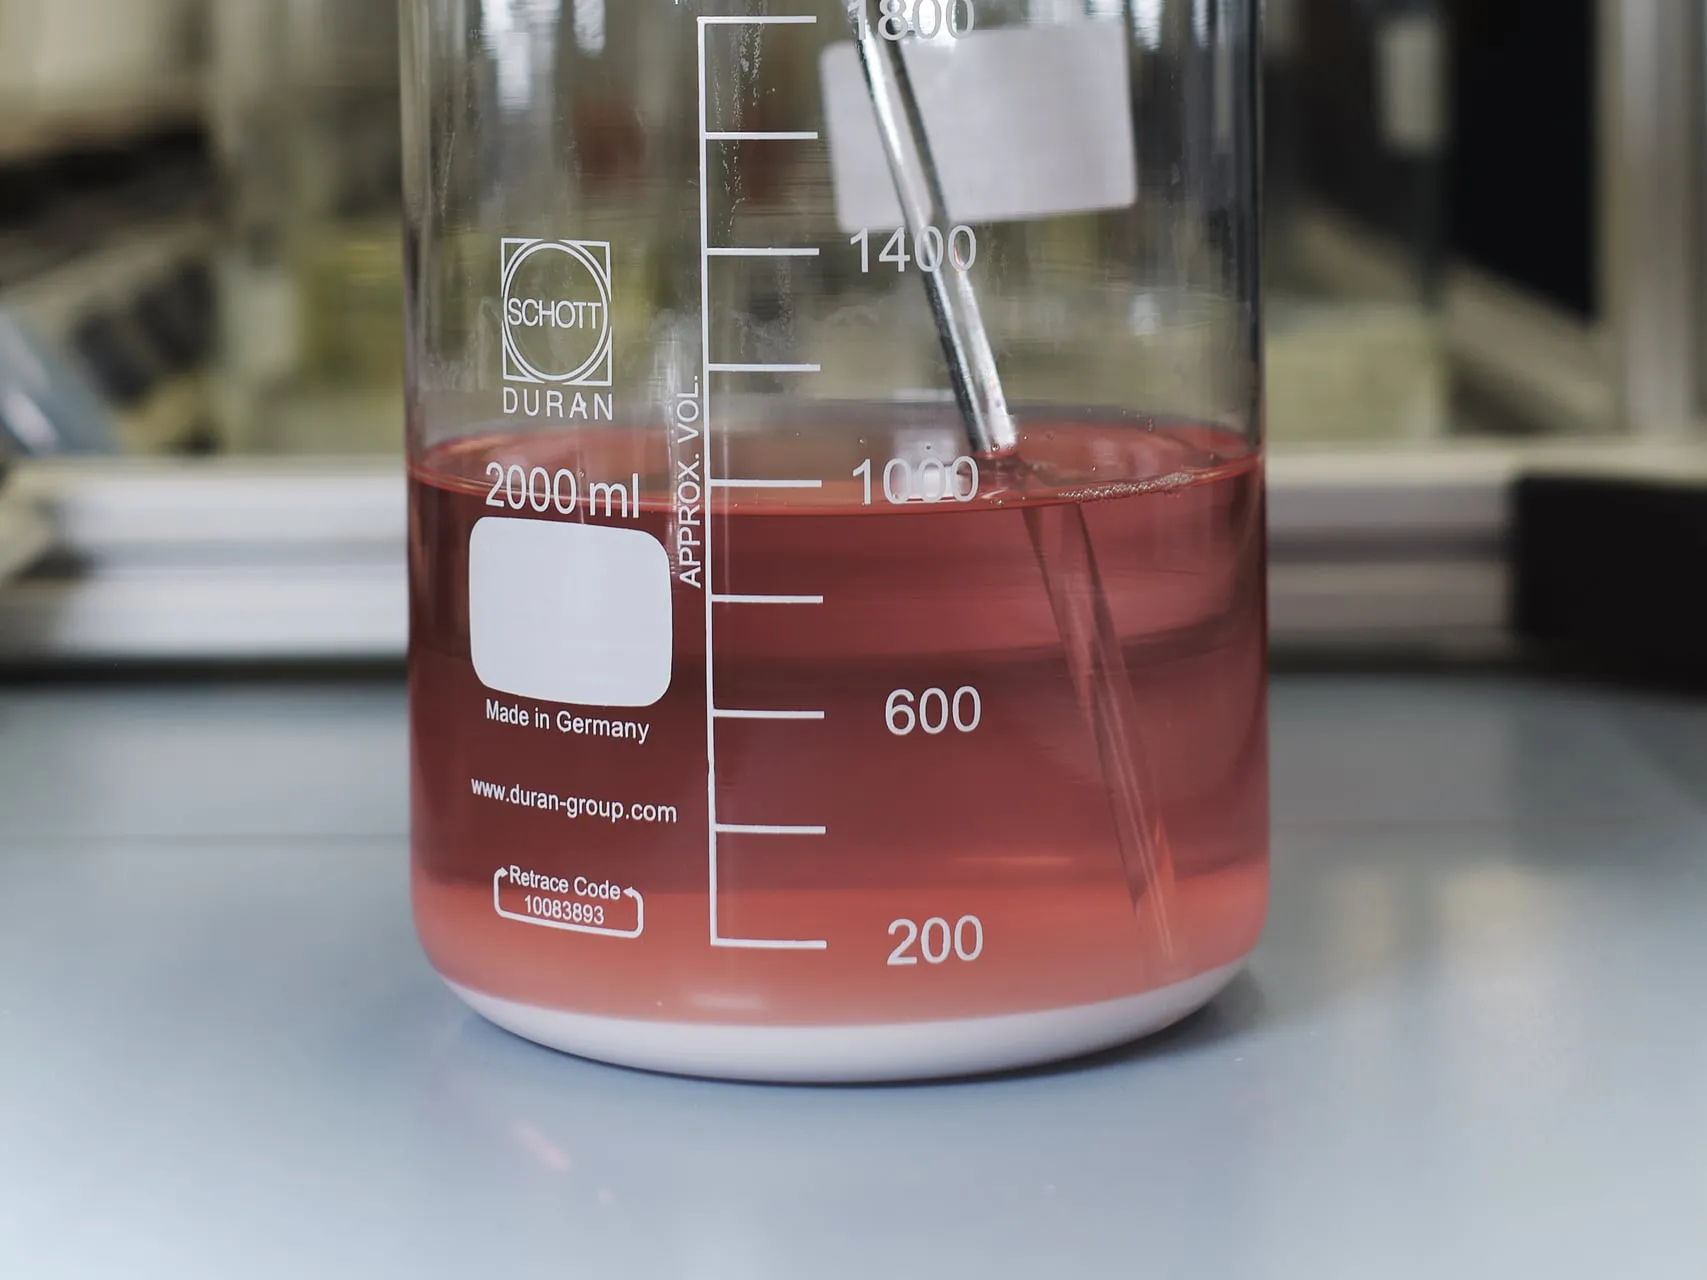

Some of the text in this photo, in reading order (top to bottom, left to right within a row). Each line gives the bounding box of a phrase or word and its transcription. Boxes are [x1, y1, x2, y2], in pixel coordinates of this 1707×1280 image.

[849, 224, 977, 273] 1400
[508, 297, 602, 329] SCHOTT
[503, 387, 613, 420] DURAN
[485, 462, 640, 519] 2000 ml
[676, 375, 701, 589] APPROX. VOL.
[851, 455, 980, 505] 1000
[486, 699, 650, 744] Made in Germany
[884, 686, 982, 735] 600
[471, 778, 677, 823] www.duran-group.com
[509, 865, 621, 900] Retrace Code
[524, 895, 605, 925] 10083893
[887, 915, 983, 965] 200
